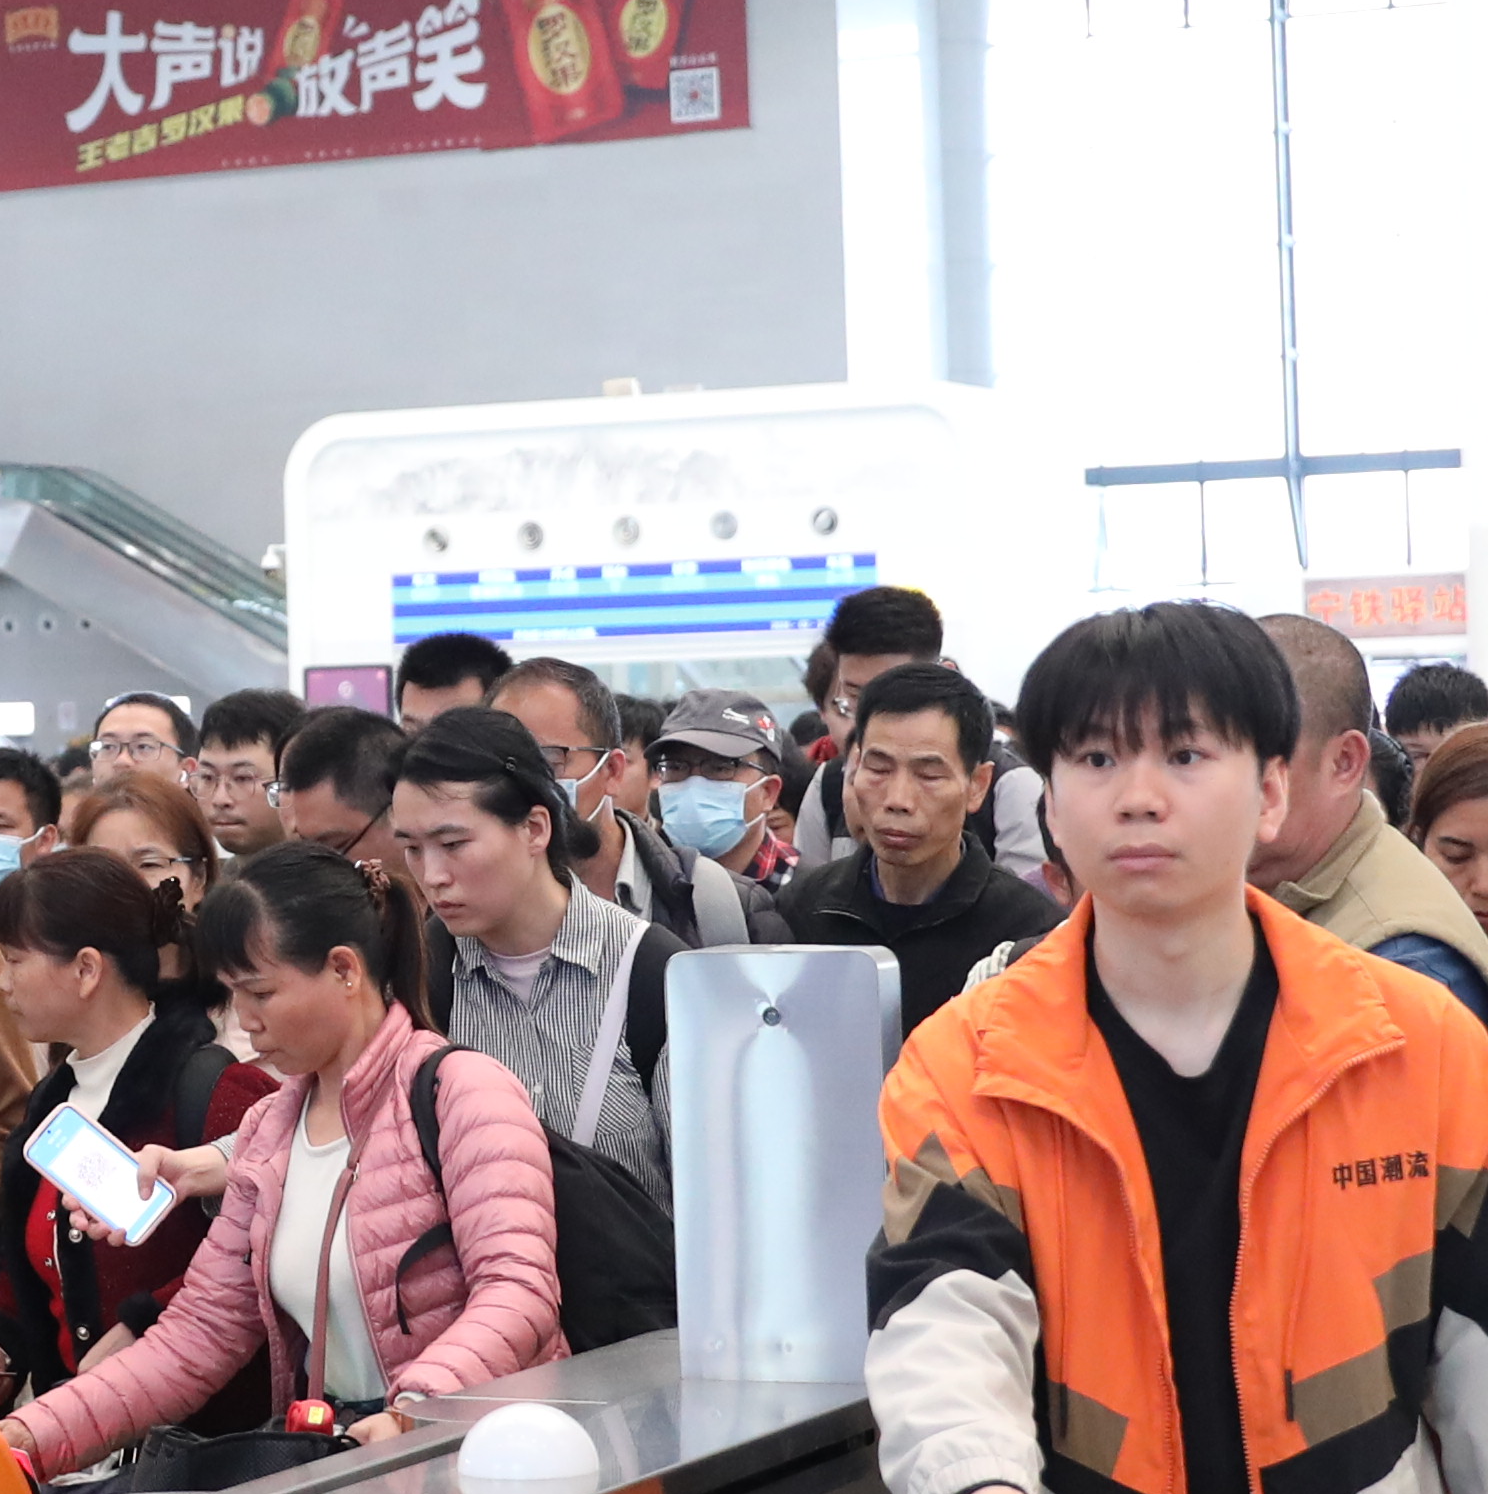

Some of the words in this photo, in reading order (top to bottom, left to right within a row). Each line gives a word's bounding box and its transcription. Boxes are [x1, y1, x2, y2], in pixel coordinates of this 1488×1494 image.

[65, 10, 264, 133] 大声说
[1308, 584, 1465, 626] 宁铁驿站
[1332, 1150, 1429, 1190] 中国潮流
